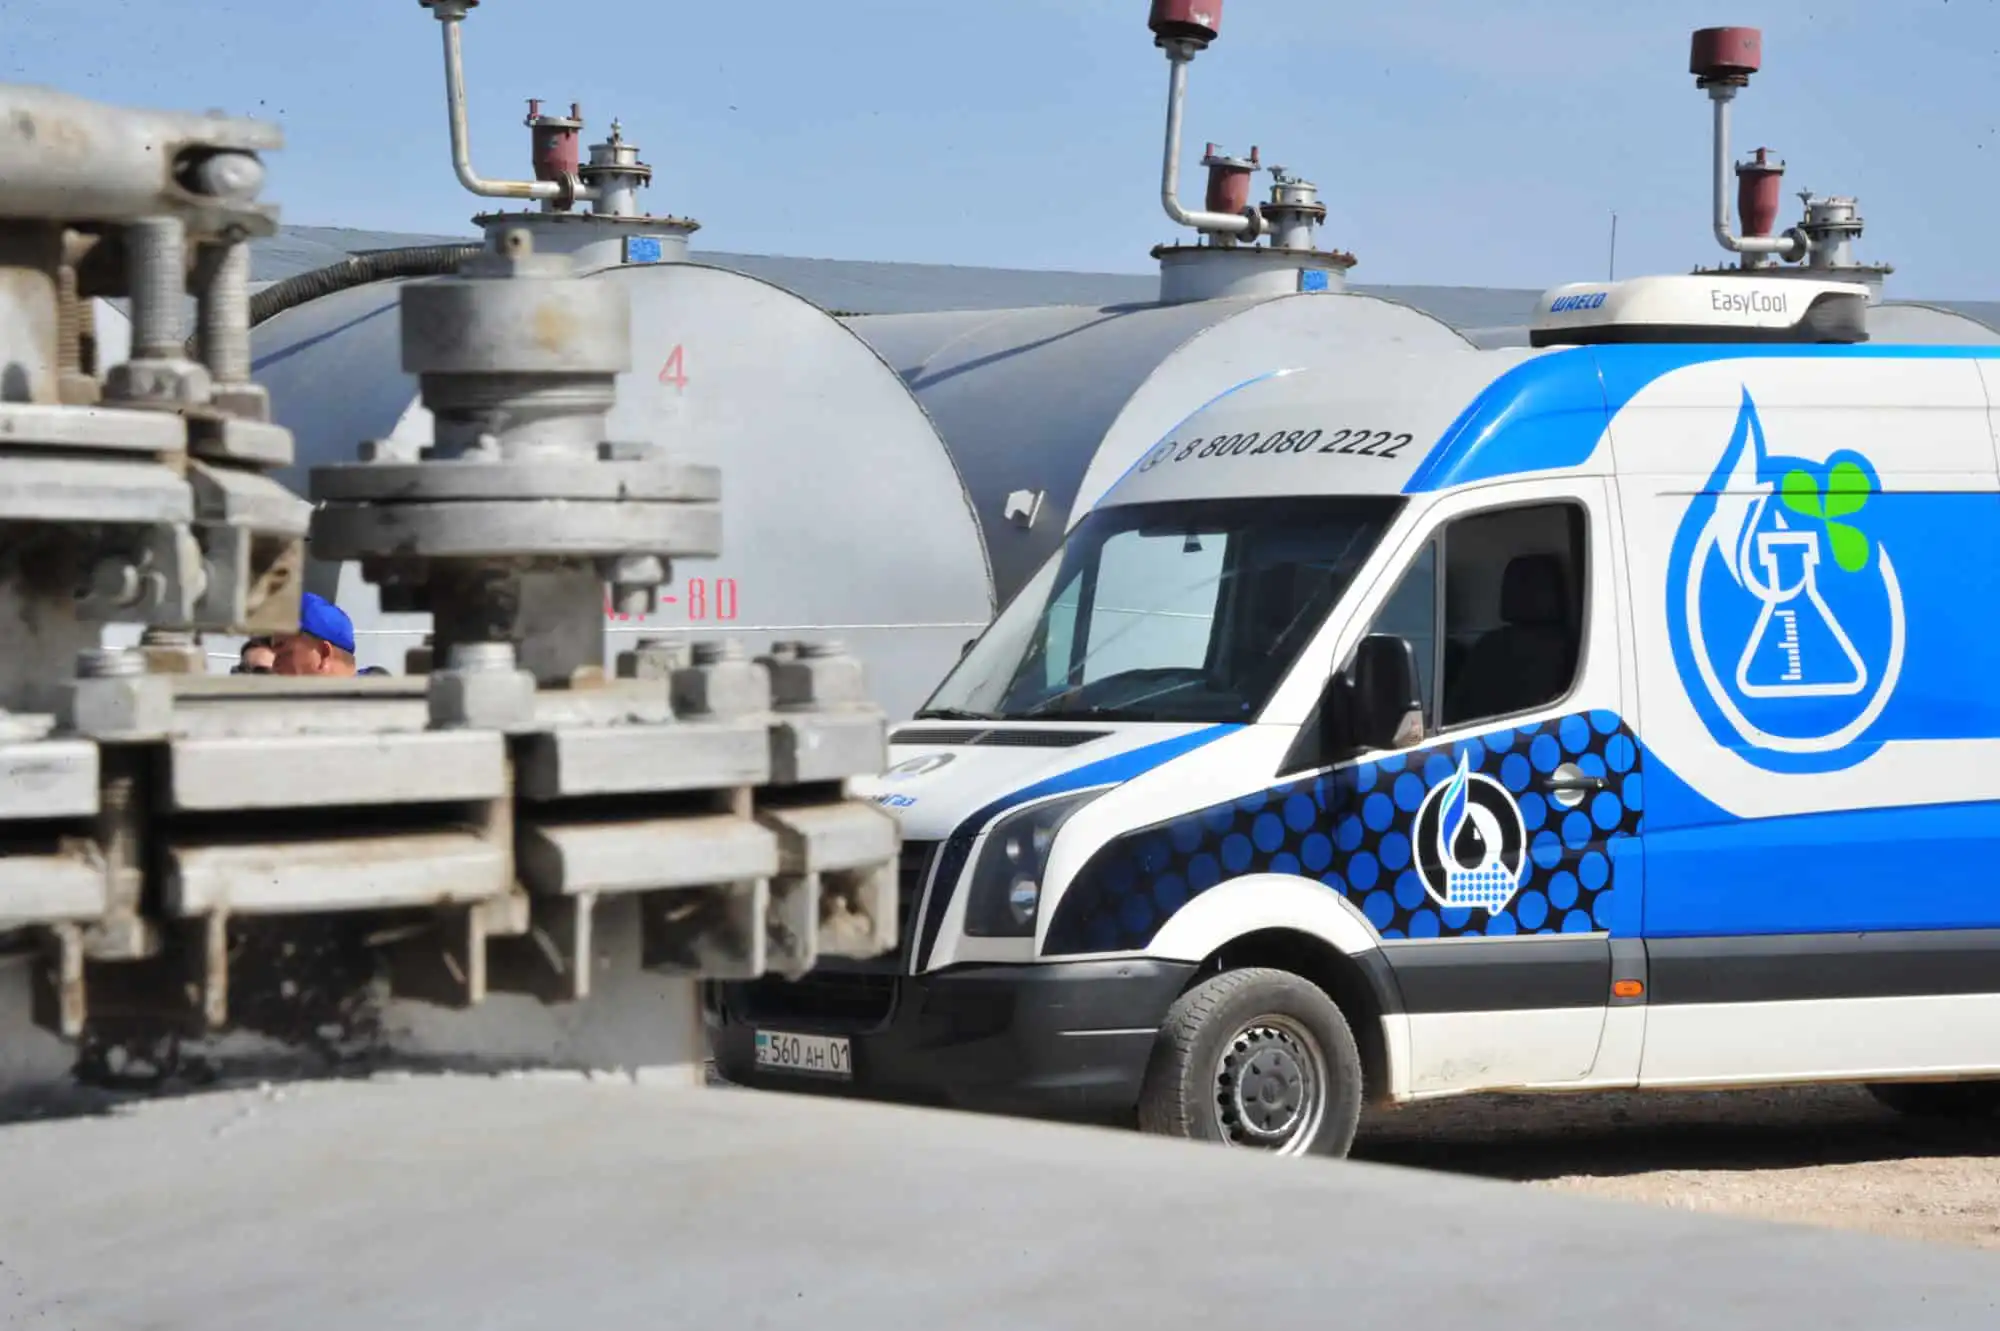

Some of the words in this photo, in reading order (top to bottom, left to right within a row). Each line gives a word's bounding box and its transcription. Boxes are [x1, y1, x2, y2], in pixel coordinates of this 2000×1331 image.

[1711, 289, 1787, 316] EasyCool
[658, 343, 689, 389] 4
[1174, 438, 1204, 462] 8
[1316, 429, 1413, 459] 2222
[771, 1035, 800, 1065] 560
[831, 1042, 850, 1071] 01
